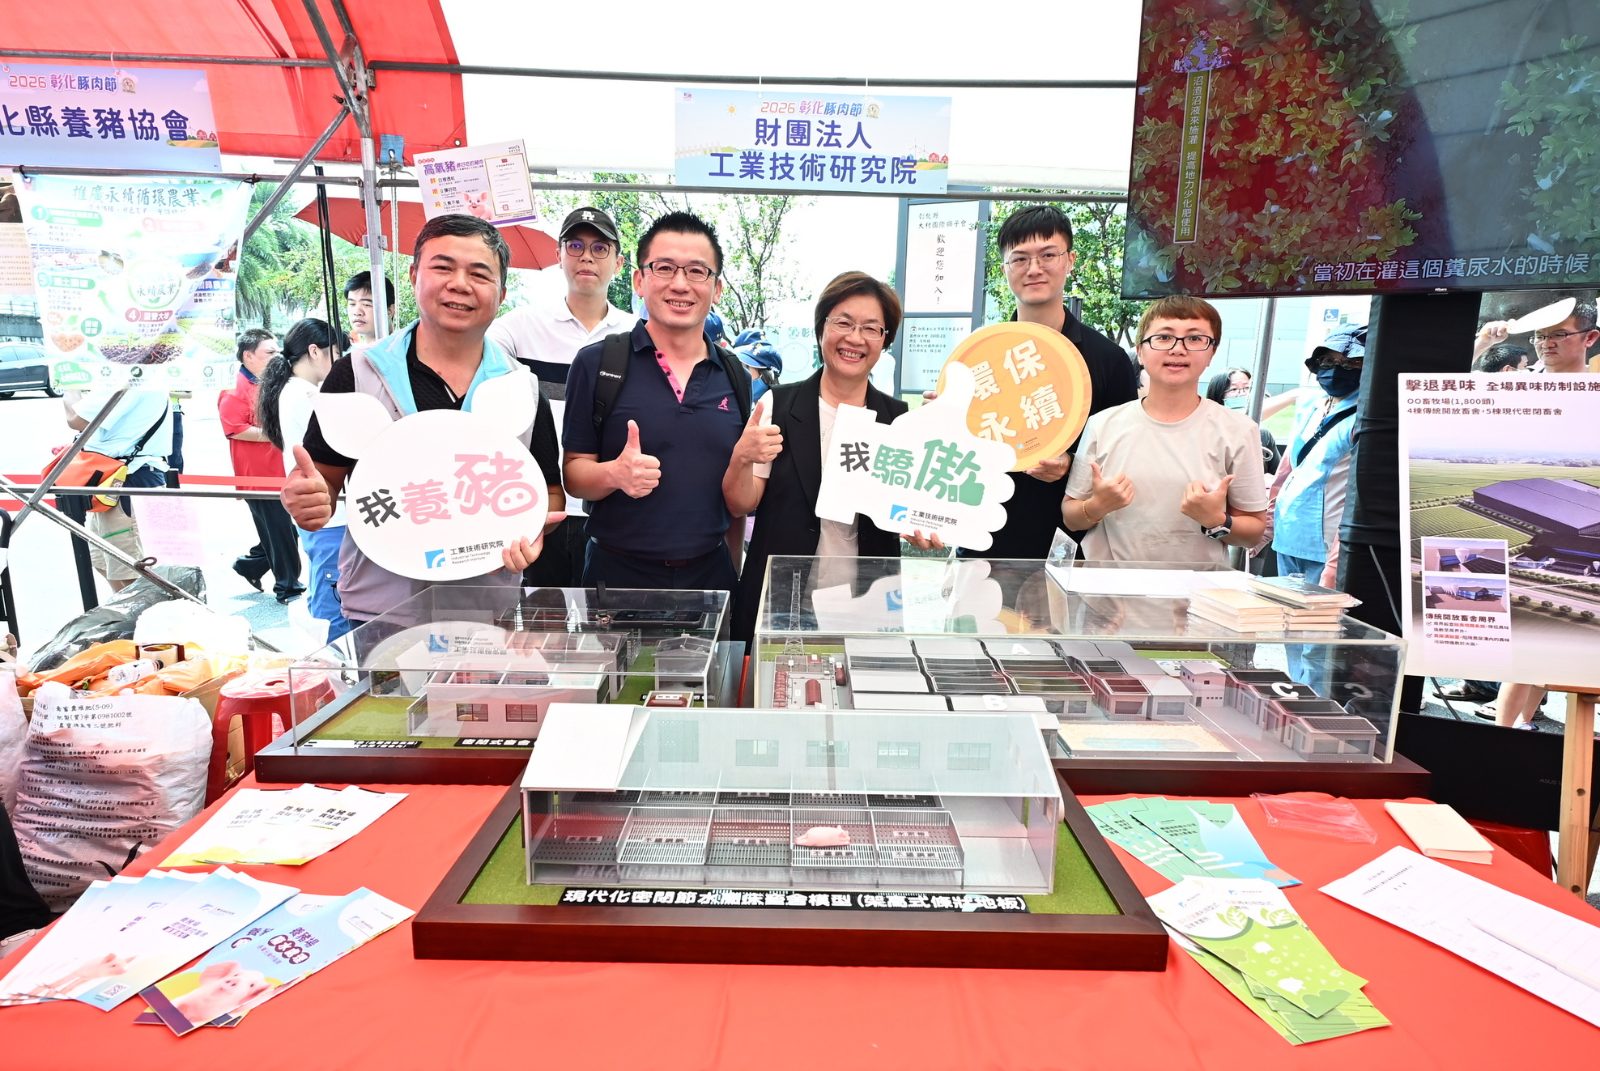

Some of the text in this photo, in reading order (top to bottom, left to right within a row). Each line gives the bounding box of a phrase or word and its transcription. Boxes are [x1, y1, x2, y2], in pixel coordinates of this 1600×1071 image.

[9, 74, 118, 92] 2026 彰化豚肉節
[760, 100, 863, 117] 2026 彰化豚肉節
[754, 118, 873, 150] 財團法人
[708, 152, 918, 185] 工業技術研究院
[1313, 253, 1590, 282] 當初在灌這個糞尿水的時候
[972, 339, 1046, 401] 環保
[1406, 379, 1476, 392] 擊退異味
[977, 383, 1065, 442] 永續
[840, 439, 985, 506] 我驕傲
[356, 451, 538, 527] 我養豬
[450, 540, 504, 556] 工業技術研究院
